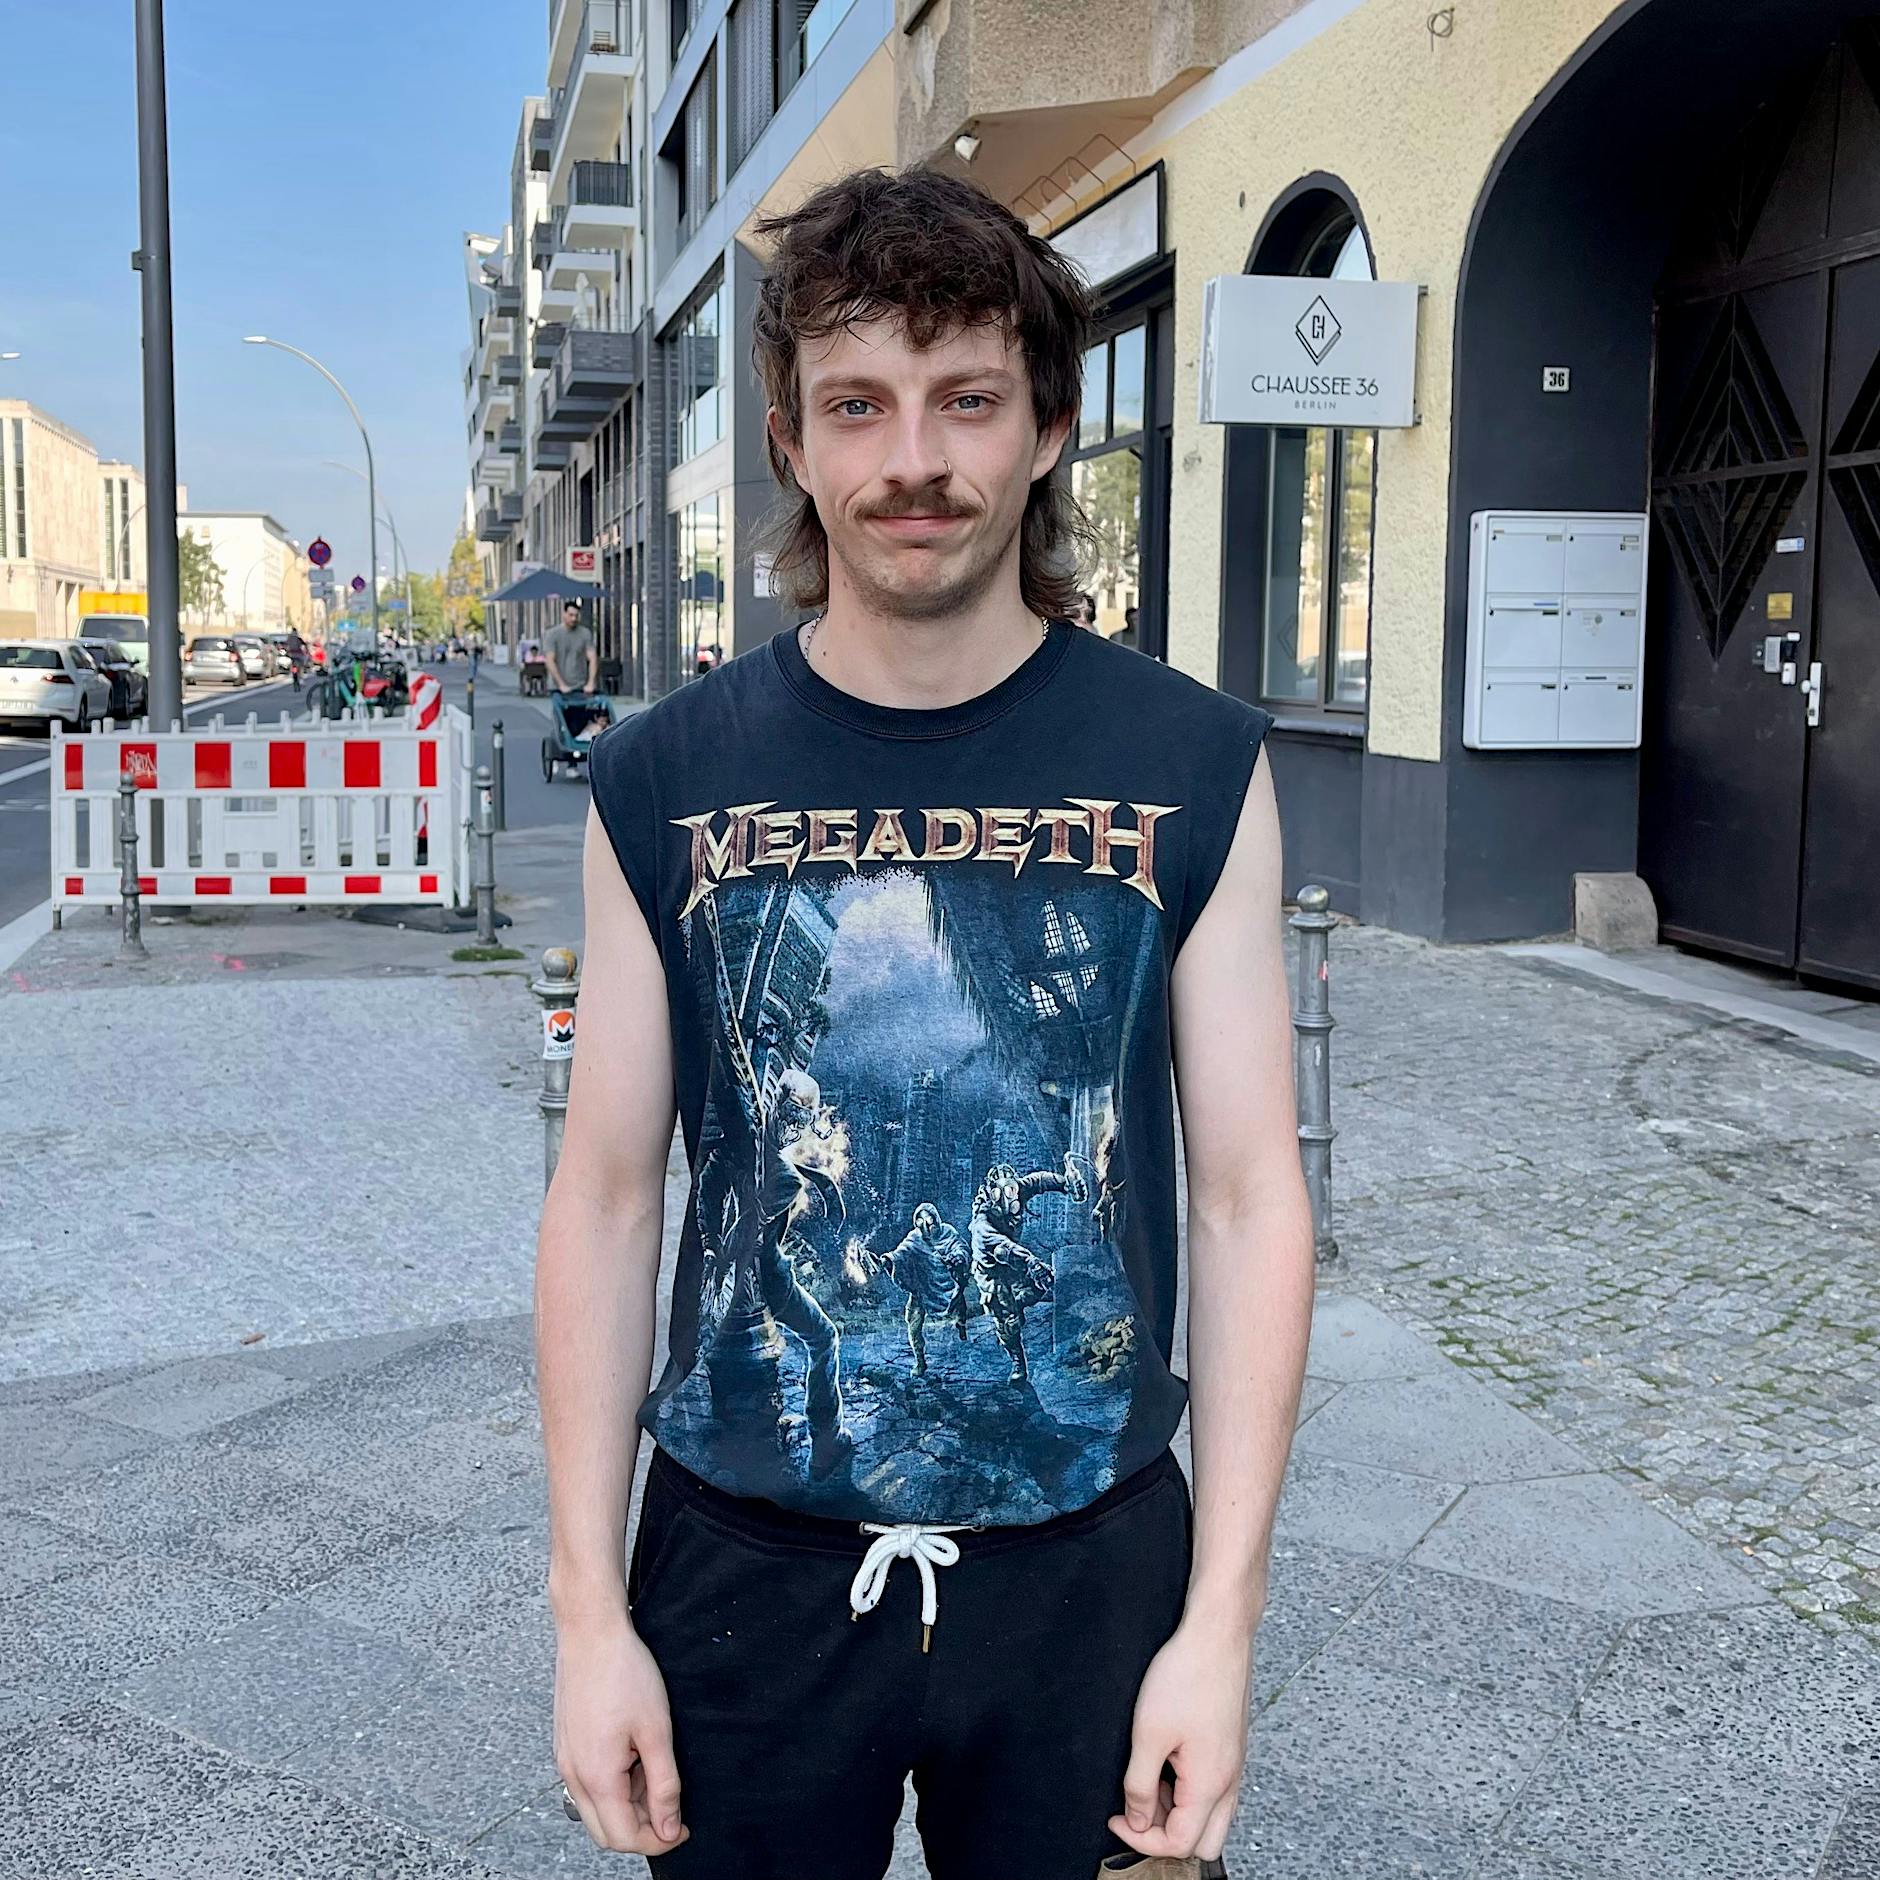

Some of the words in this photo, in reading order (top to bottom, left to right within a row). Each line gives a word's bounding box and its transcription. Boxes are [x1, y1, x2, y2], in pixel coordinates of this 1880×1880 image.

[1312, 315, 1325, 339] CH
[1251, 374, 1351, 396] CHAUSSEE
[1355, 377, 1379, 397] 36
[1549, 371, 1565, 387] 36
[1294, 400, 1337, 410] BERLIN
[669, 797, 1184, 920] MEGADETH
